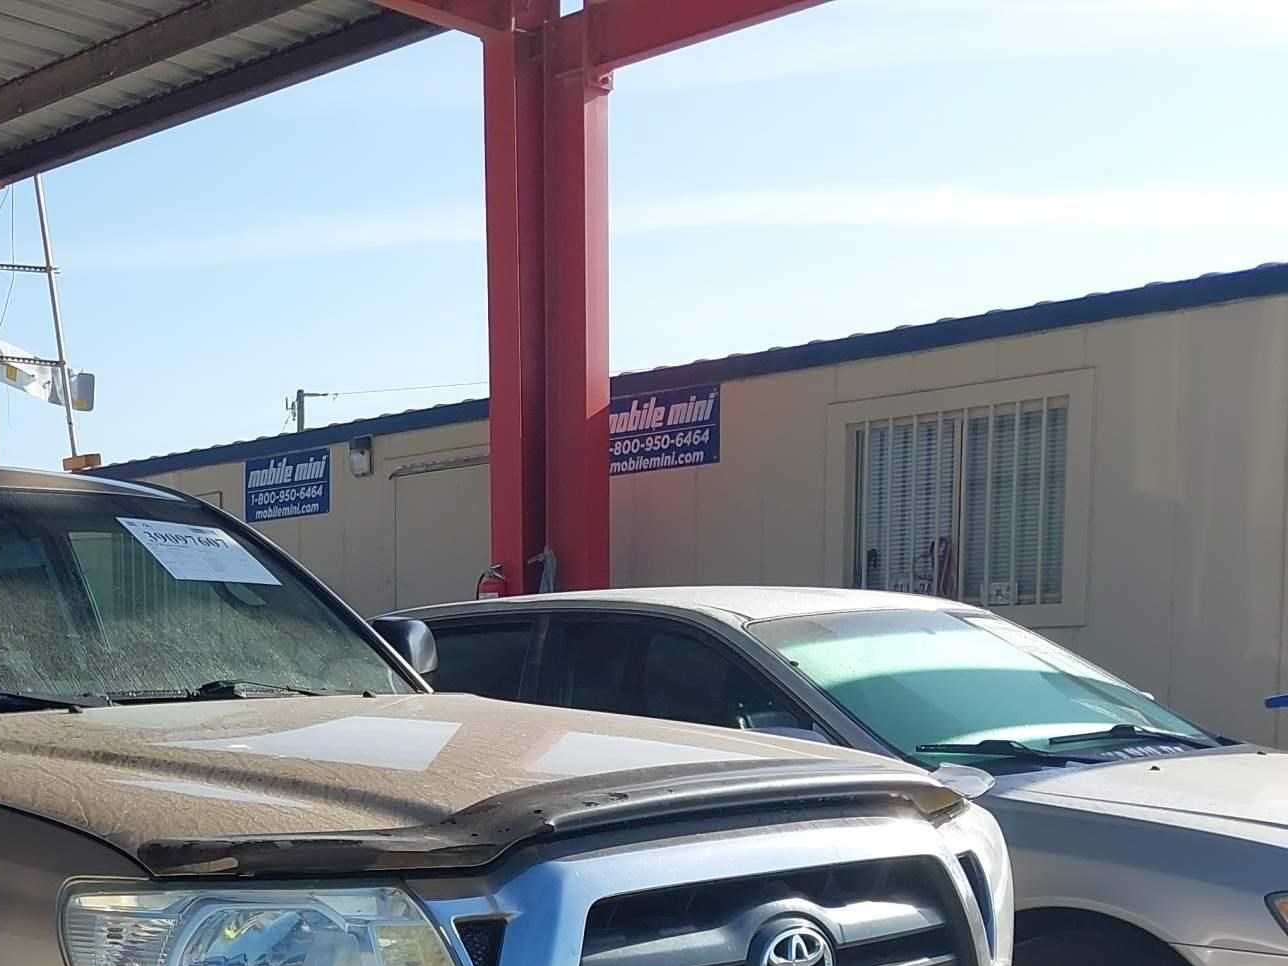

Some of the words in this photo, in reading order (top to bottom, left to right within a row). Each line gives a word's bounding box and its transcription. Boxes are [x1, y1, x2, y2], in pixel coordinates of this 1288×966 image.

[667, 393, 717, 426] mini
[609, 428, 710, 456] -800-950-6464
[248, 458, 293, 489] mobile
[295, 455, 328, 481] mini
[610, 451, 704, 473] mobilemini.com
[251, 484, 323, 506] 1-800-950-6464
[255, 503, 320, 520] mobilemini.com
